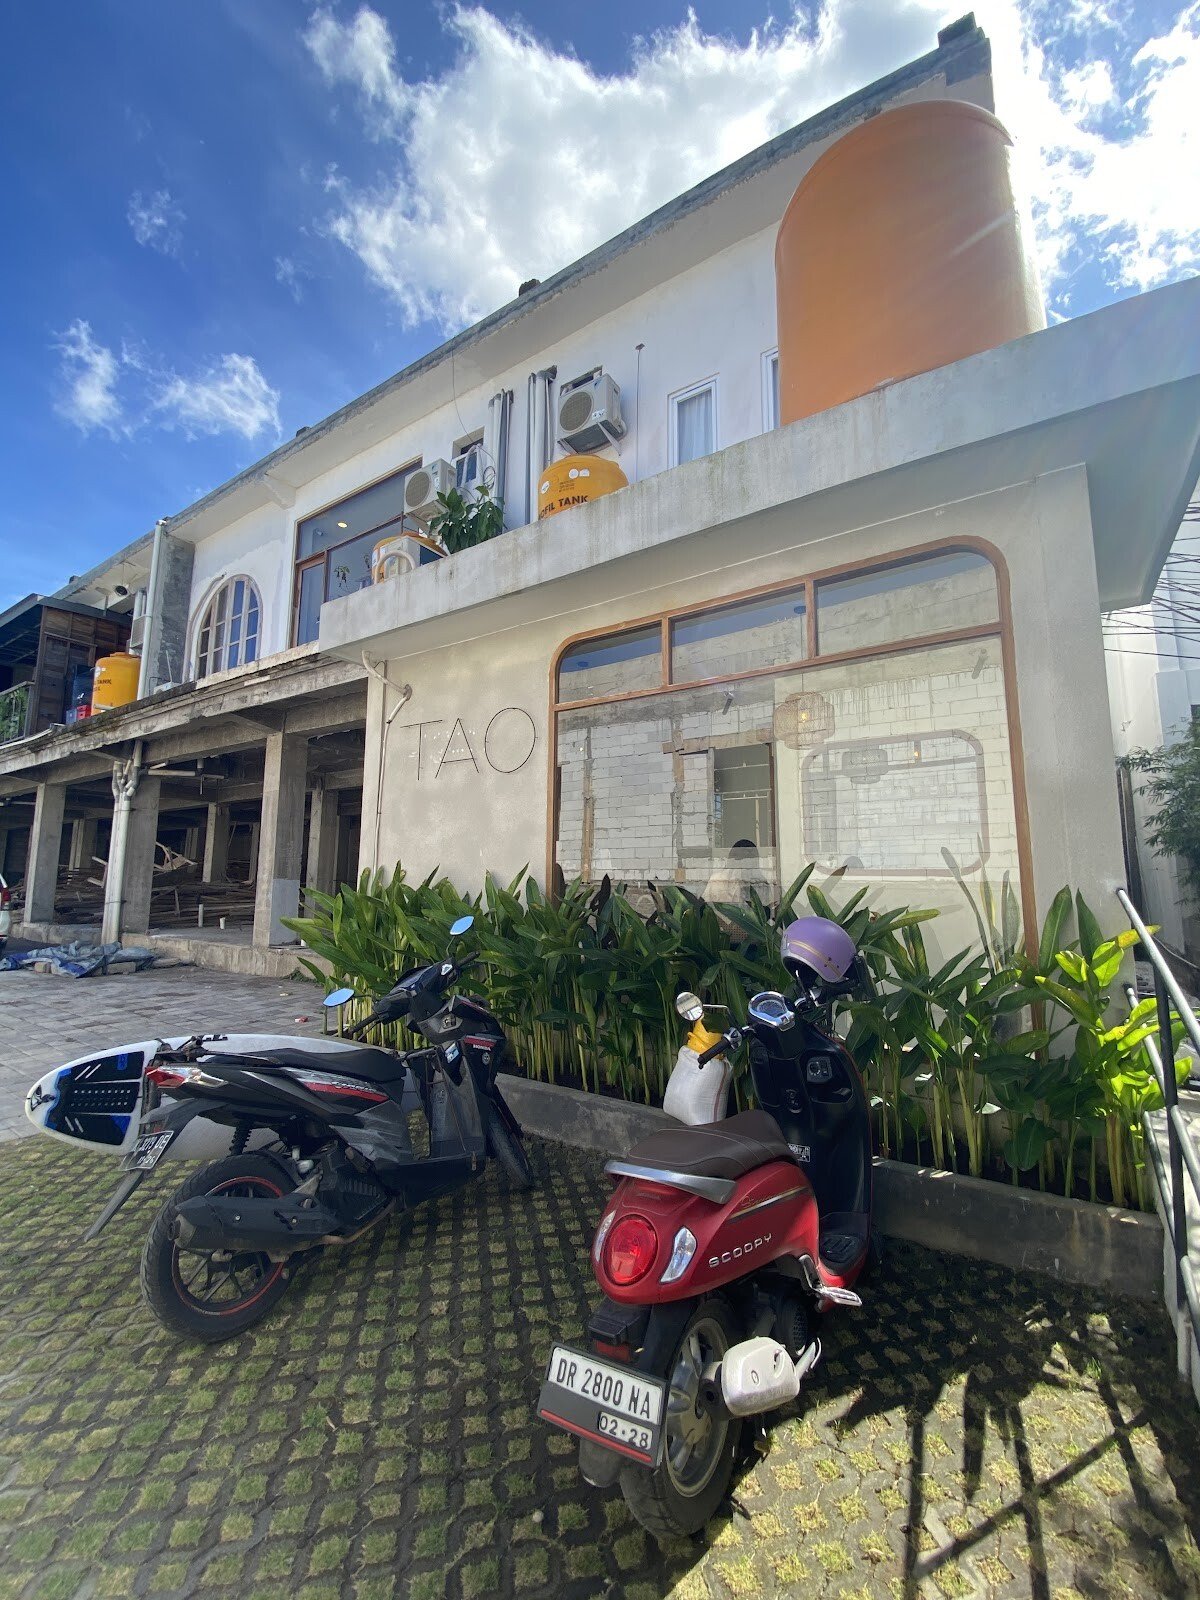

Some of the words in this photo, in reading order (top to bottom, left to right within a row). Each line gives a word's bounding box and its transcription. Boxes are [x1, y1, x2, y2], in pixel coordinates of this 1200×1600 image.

[558, 495, 588, 507] TANK
[400, 707, 536, 780] TAO
[708, 1232, 772, 1268] SCOOPY
[556, 1358, 577, 1388] DR
[581, 1368, 624, 1406] 2800
[628, 1385, 650, 1419] NA
